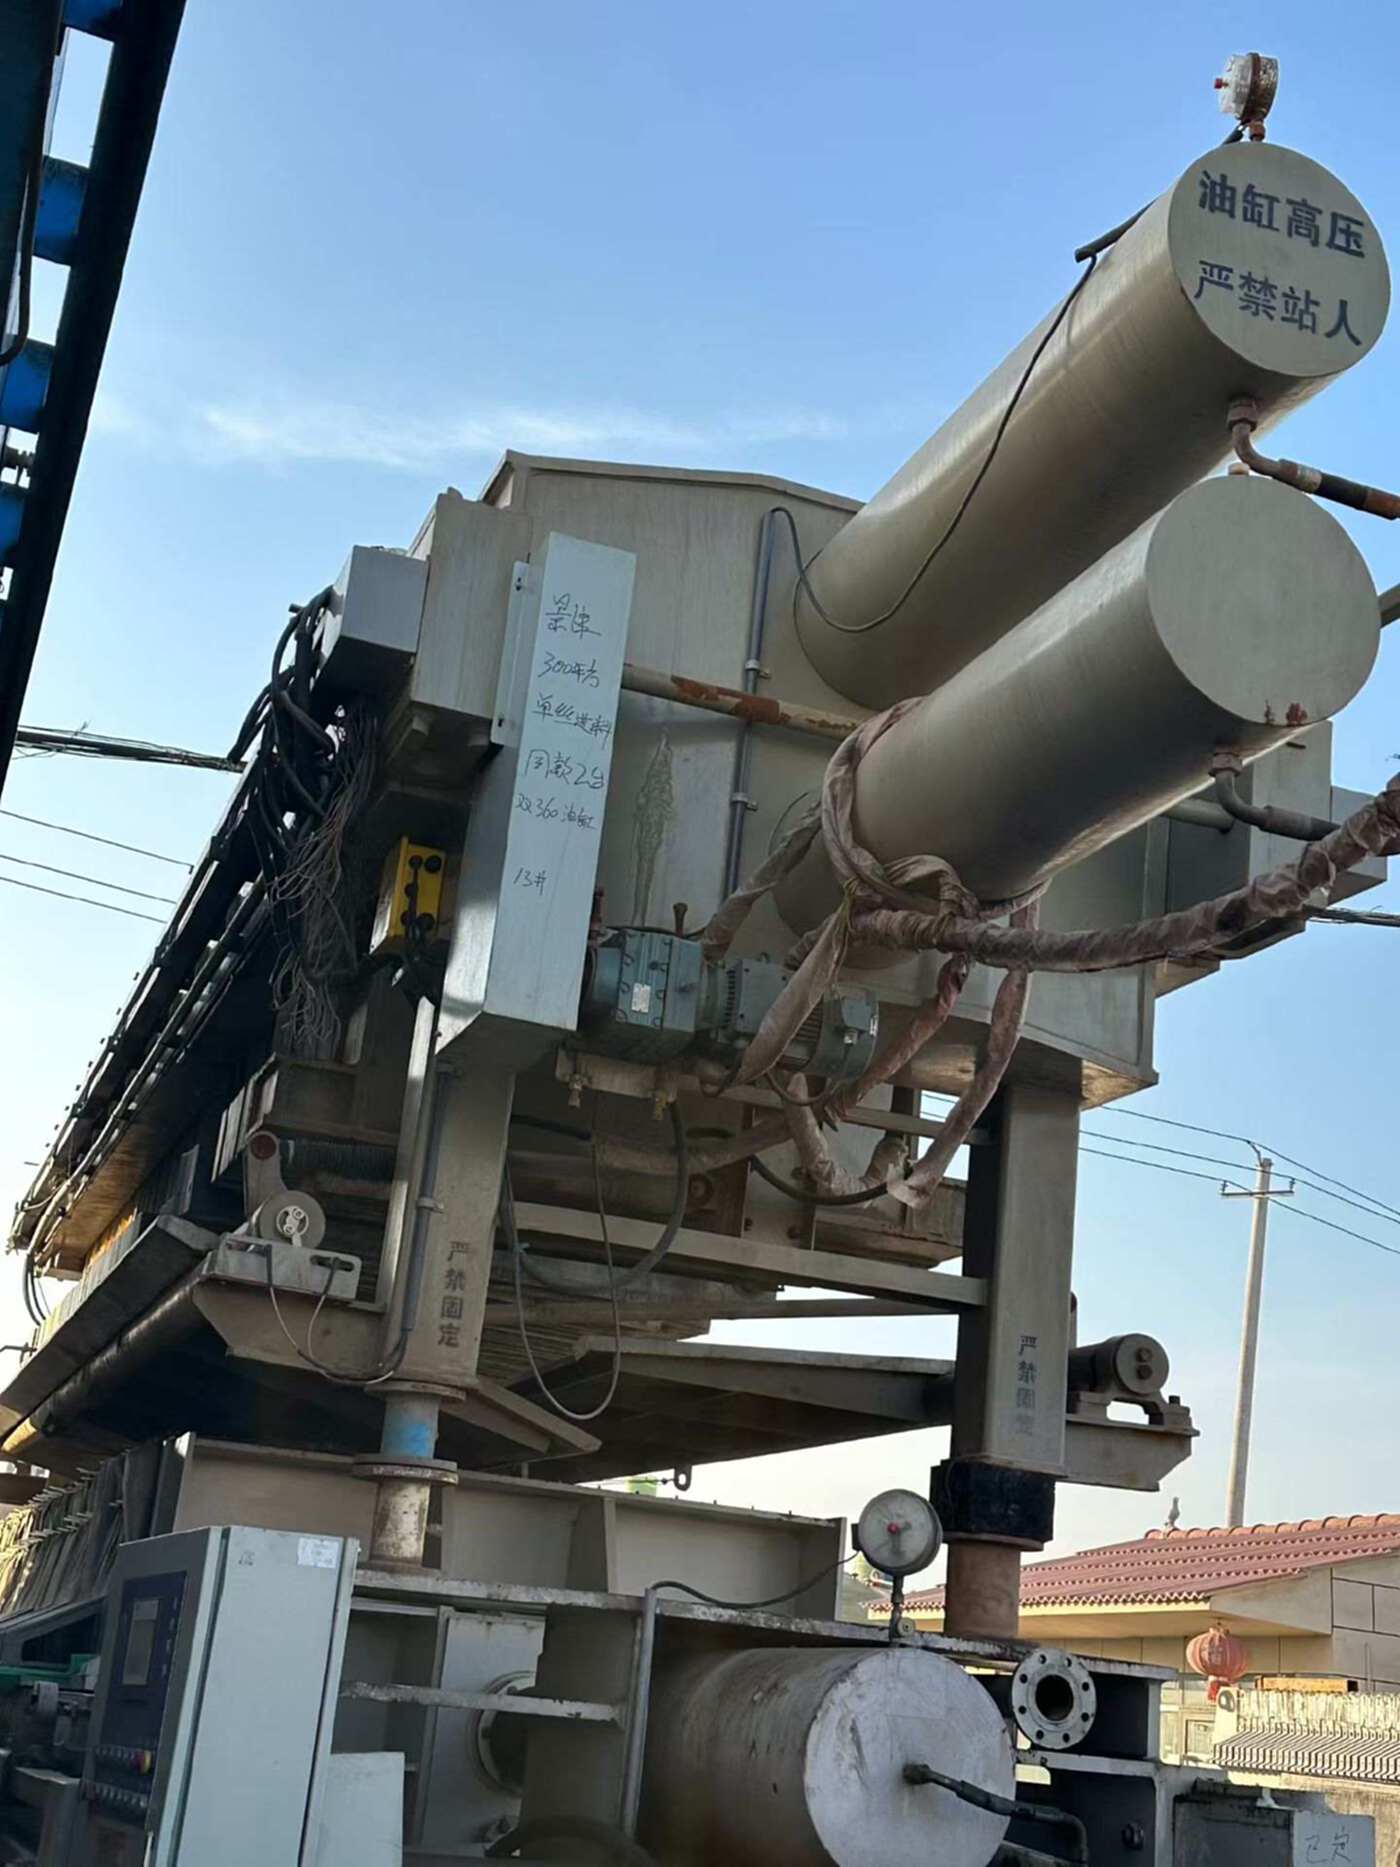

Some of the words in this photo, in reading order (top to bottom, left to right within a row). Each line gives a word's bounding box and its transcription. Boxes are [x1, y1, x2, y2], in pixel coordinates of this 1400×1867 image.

[1198, 169, 1366, 259] 油缸高压
[1194, 259, 1363, 346] 严禁站人
[538, 651, 600, 688] 300平方
[524, 748, 605, 790] 同款2台
[515, 793, 596, 830] 双360油缸
[438, 1240, 471, 1348] 严禁固定
